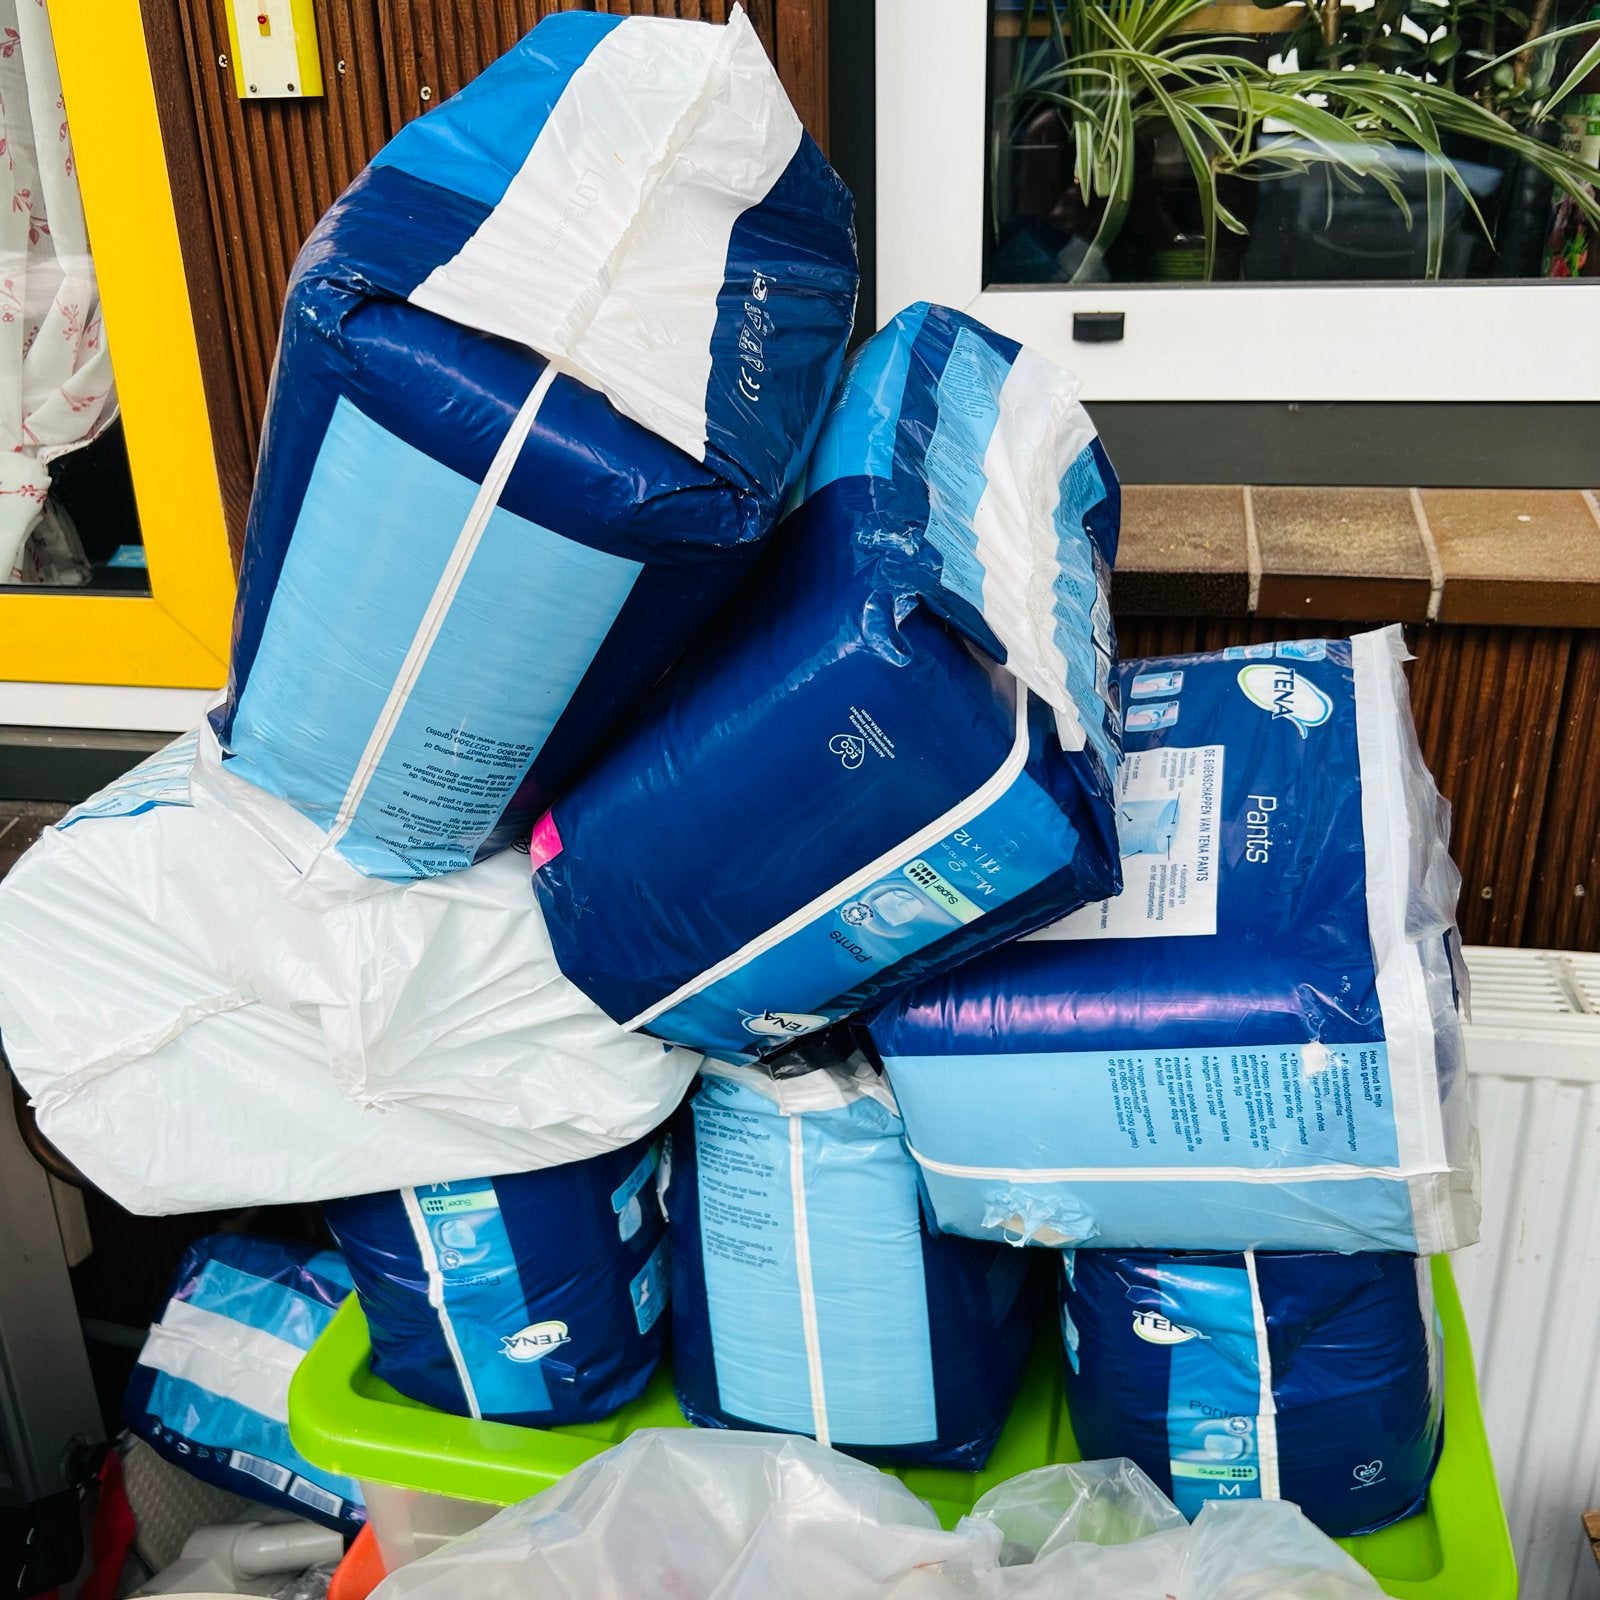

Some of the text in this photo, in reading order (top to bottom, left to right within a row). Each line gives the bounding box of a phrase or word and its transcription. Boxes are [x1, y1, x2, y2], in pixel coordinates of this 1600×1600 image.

[1271, 668, 1295, 719] TENA
[425, 727, 518, 756] 0800 0227500 (gratis)
[840, 740, 859, 760] ECO
[1196, 749, 1215, 881] DE EIGENSCHAPPEN VAN TENA PANTS
[954, 826, 972, 847] 12
[1245, 791, 1276, 865] Pants
[933, 880, 958, 905] Super
[829, 930, 872, 963] Pants
[763, 1008, 809, 1035] TENA
[1117, 1059, 1126, 1070] Bel
[1369, 1050, 1377, 1064] Hoe
[1109, 1067, 1116, 1077] ga
[1137, 1065, 1146, 1088] Vragen
[1155, 1057, 1165, 1086] het toilet
[1165, 1064, 1173, 1073] tot
[1184, 1063, 1193, 1078] Vind
[1202, 1056, 1211, 1081] hangen
[1212, 1062, 1223, 1087] Vermijd
[1231, 1055, 1243, 1096] neem de tijd
[1281, 1063, 1289, 1079] twee
[1359, 1052, 1373, 1101] blaas gezond?
[1371, 1066, 1380, 1084] houd
[1111, 1078, 1123, 1093] naar
[1119, 1071, 1129, 1091] 0800
[1126, 1058, 1142, 1113] verkrijgbaarheid?
[1167, 1082, 1175, 1095] keer
[1205, 1083, 1213, 1093] als
[1140, 1089, 1148, 1104] over
[1168, 1097, 1177, 1107] per
[1187, 1093, 1197, 1113] goede
[1216, 1089, 1225, 1109] boven
[1240, 1055, 1260, 1148] met een holle gestrekte rug en
[1248, 1054, 1262, 1089] geforceerd
[1259, 1125, 1268, 1134] Ga
[1283, 1094, 1292, 1105] per
[1290, 1059, 1299, 1078] Drink
[1297, 1116, 1309, 1145] anderhalf
[1373, 1093, 1383, 1108] mijn
[1123, 1096, 1135, 1127] 0227500
[1171, 1108, 1179, 1120] dag
[1173, 1057, 1195, 1152] meeste mensen gaan tussen de
[1206, 1100, 1217, 1116] plast
[1263, 1092, 1274, 1116] probeer
[1269, 1117, 1277, 1129] niet
[1285, 1106, 1294, 1119] dag
[1314, 1086, 1325, 1132] arts om advies
[1143, 1105, 1155, 1137] vergoeding
[1219, 1110, 1227, 1120] het
[1128, 1128, 1139, 1148] (gratis)
[1174, 1121, 1182, 1135] naar
[1195, 1137, 1203, 1145] de
[1130, 1310, 1188, 1334] TEN
[500, 1330, 569, 1350] TENA
[1219, 1483, 1240, 1496] M
